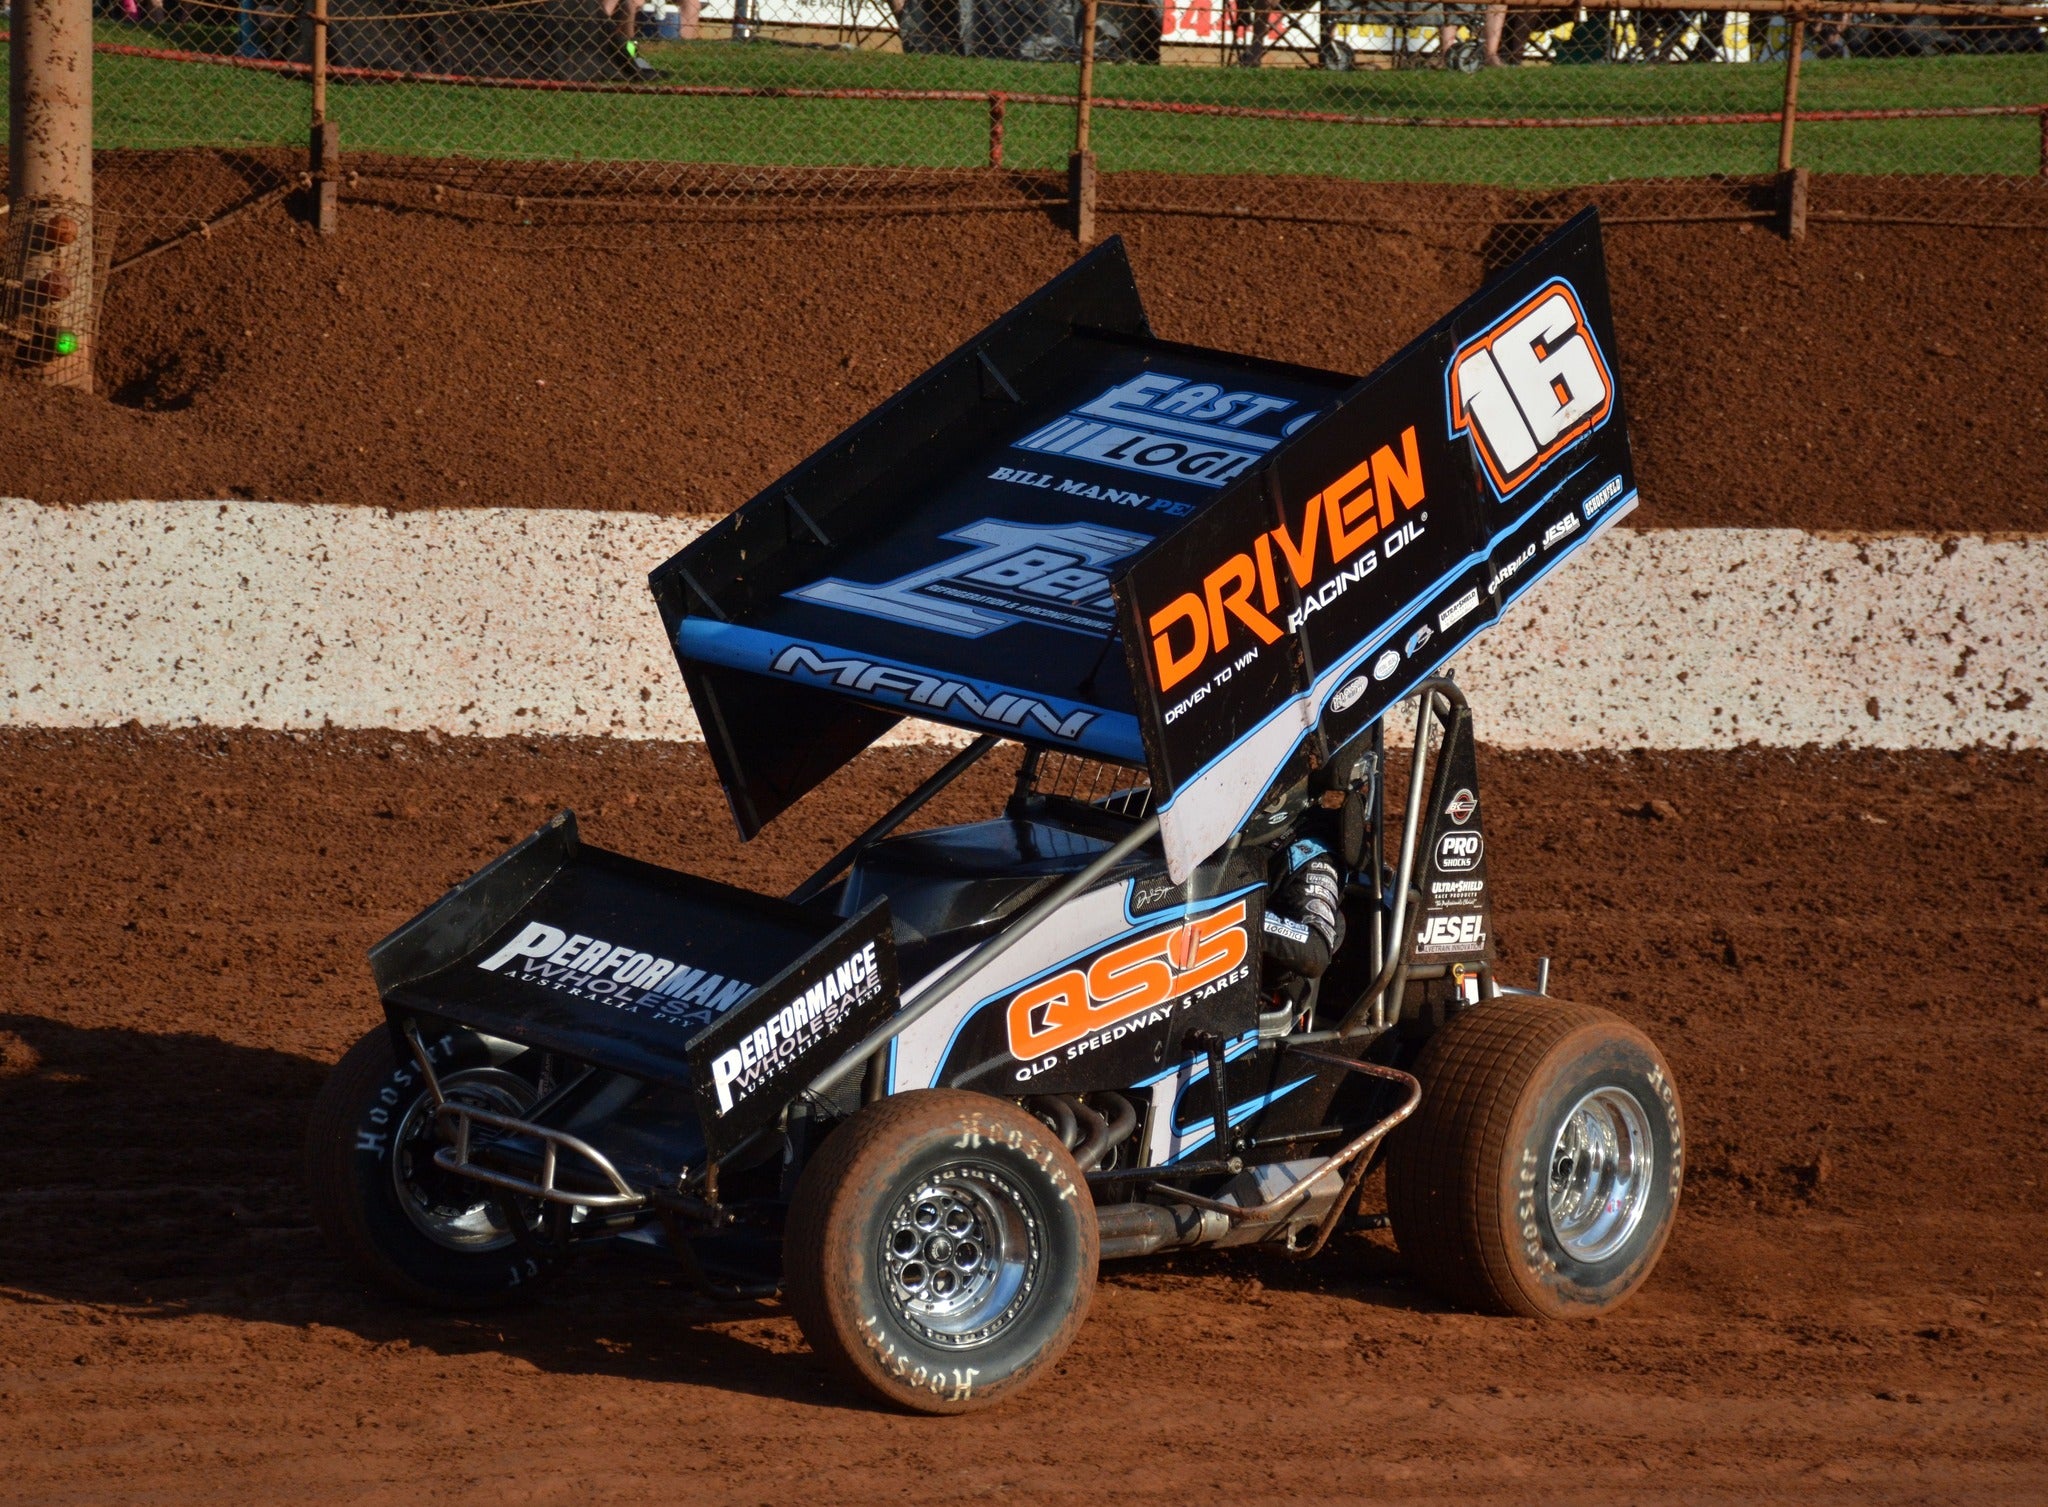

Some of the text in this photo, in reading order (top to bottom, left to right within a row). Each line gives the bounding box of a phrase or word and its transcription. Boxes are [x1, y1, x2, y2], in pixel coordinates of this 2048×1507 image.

[1072, 371, 1299, 431] EAST
[1452, 285, 1611, 490] 16
[987, 467, 1195, 518] BILL MANN PE
[1102, 436, 1248, 483] LOGI
[1149, 425, 1426, 692] DRIVEN
[1542, 512, 1580, 546] JESEL
[1287, 549, 1378, 634] RACING
[1488, 543, 1536, 595] CARRILLO
[772, 644, 1097, 739] MANN
[1164, 647, 1259, 725] DRIVEN TO WIN
[1442, 837, 1479, 857] PRO
[1443, 858, 1472, 867] SHOCKS
[1418, 915, 1487, 945] JESEL
[504, 970, 696, 1029] AUSTRALIA PTY
[1007, 890, 1248, 1060] QSS
[712, 941, 878, 1115] PERFORMANCE
[735, 969, 881, 1089] WHOLESALE
[738, 984, 882, 1102] AUSTRALIA PTY LTD
[1015, 1056, 1058, 1082] QLD
[1067, 1005, 1173, 1060] SPEEDWAY
